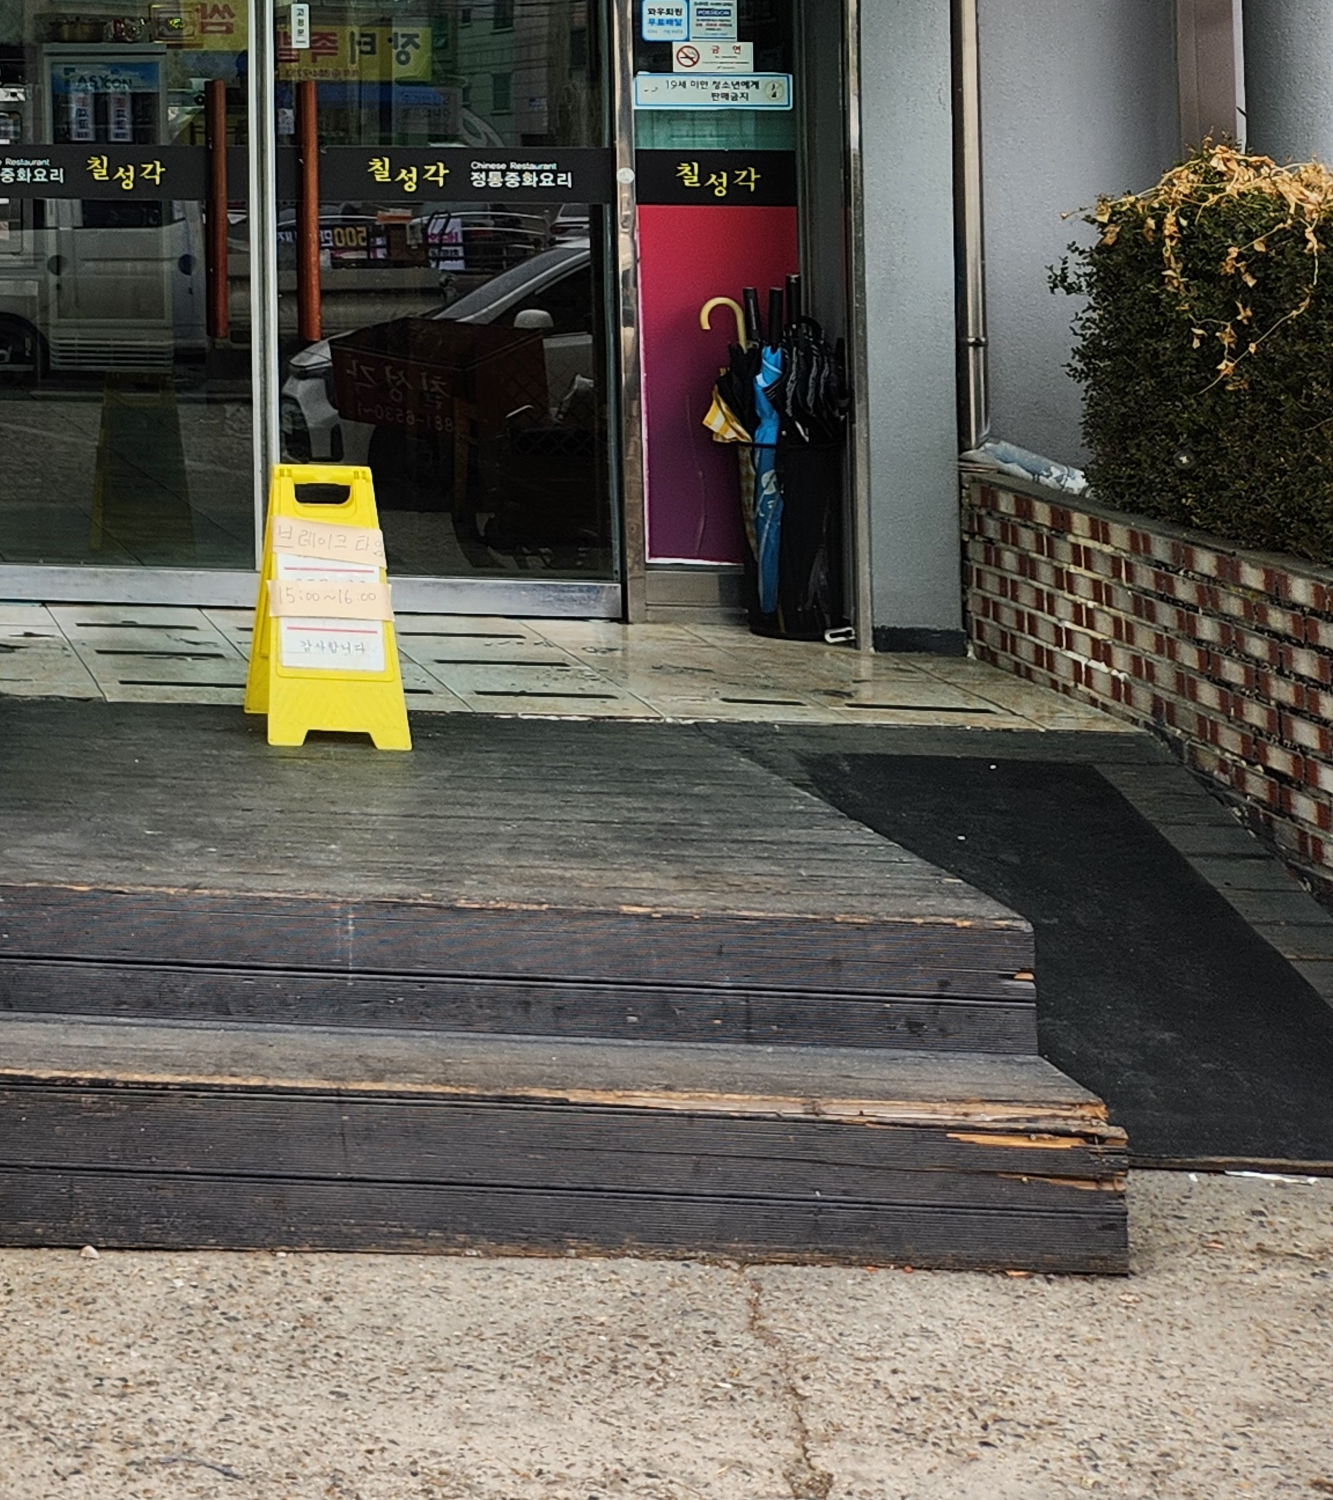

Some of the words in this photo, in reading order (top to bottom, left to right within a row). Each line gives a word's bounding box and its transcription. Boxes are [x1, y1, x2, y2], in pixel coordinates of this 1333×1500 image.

[665, 80, 687, 90] 19세
[690, 80, 709, 90] 미만
[712, 79, 760, 90] 청소년에게
[711, 91, 749, 102] 판매금지
[5, 157, 50, 166] Restaurant
[470, 161, 507, 170] Chinese
[510, 161, 558, 170] Restaurant
[85, 154, 166, 190] 칠성각
[367, 157, 450, 193] 칠성각
[470, 171, 573, 189] 정통중화요리
[674, 162, 762, 198] 칠성각
[273, 524, 348, 550] 브레이크
[300, 639, 366, 655] 감사합니다
